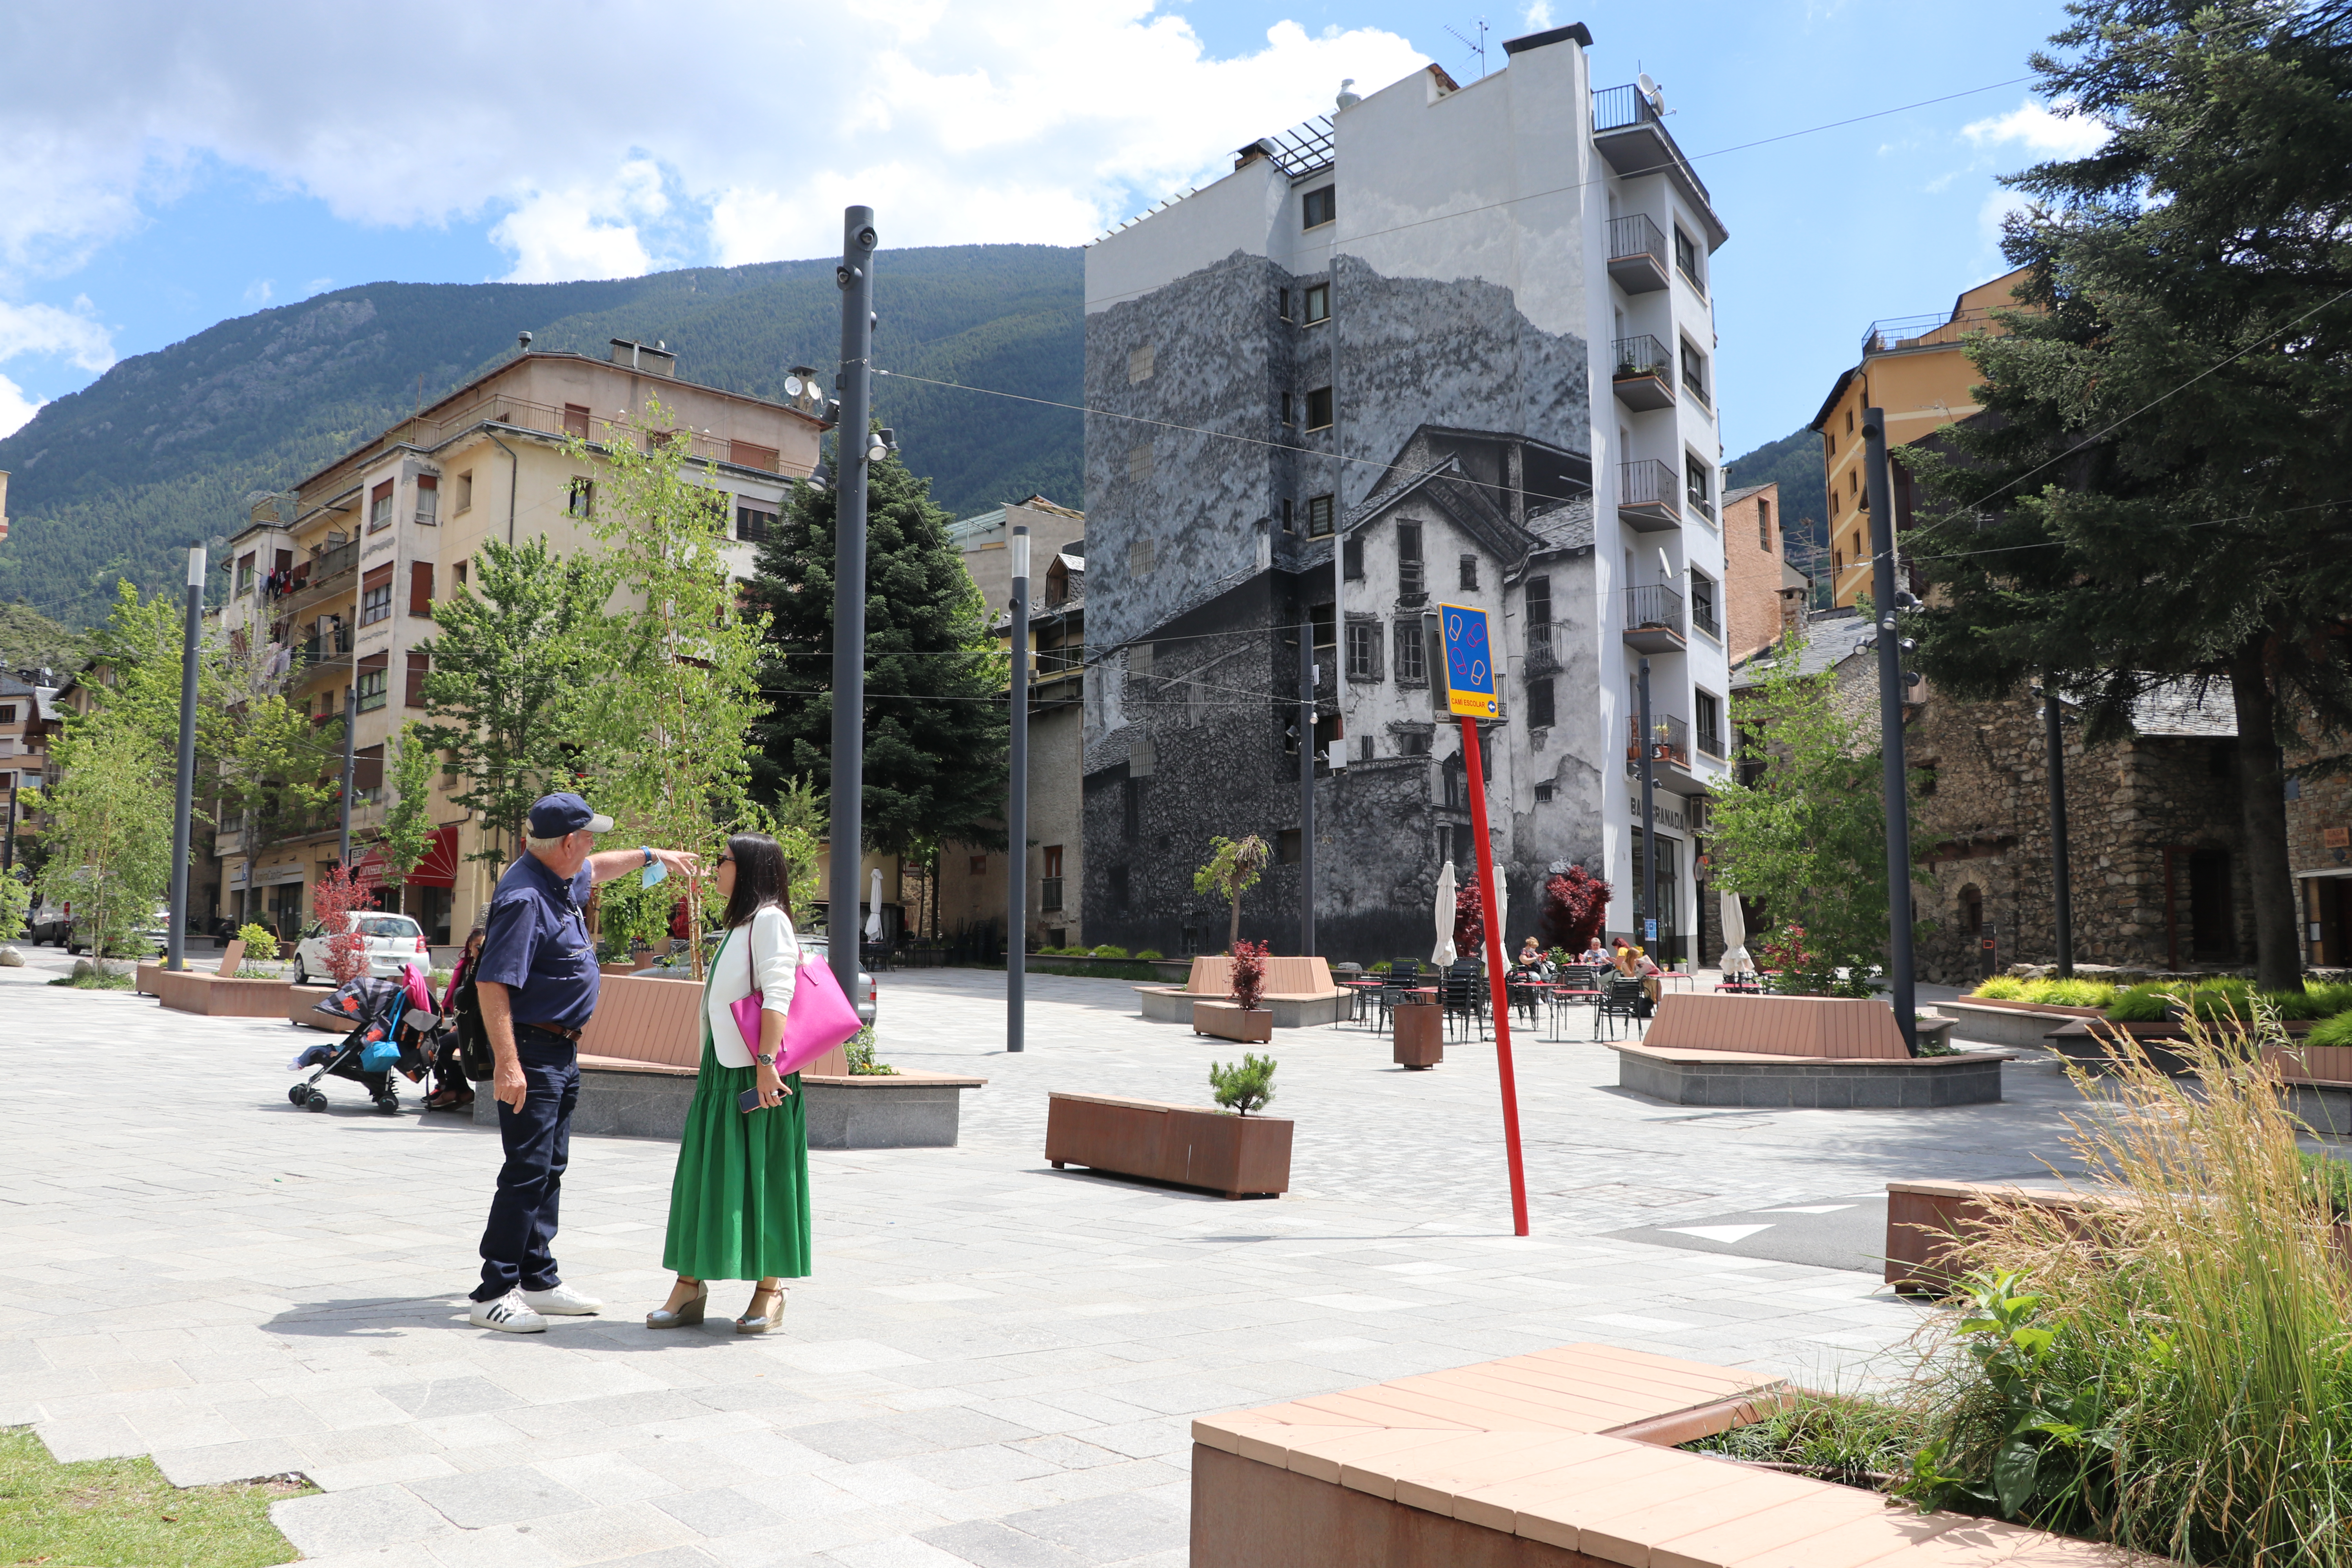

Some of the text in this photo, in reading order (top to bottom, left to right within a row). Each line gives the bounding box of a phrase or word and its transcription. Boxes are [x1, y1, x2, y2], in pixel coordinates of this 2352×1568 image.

[1464, 700, 1485, 708] ESCOLAR
[1631, 797, 1642, 818] BA
[2328, 829, 2344, 837] CASA
[255, 868, 283, 883] AspiraCapital
